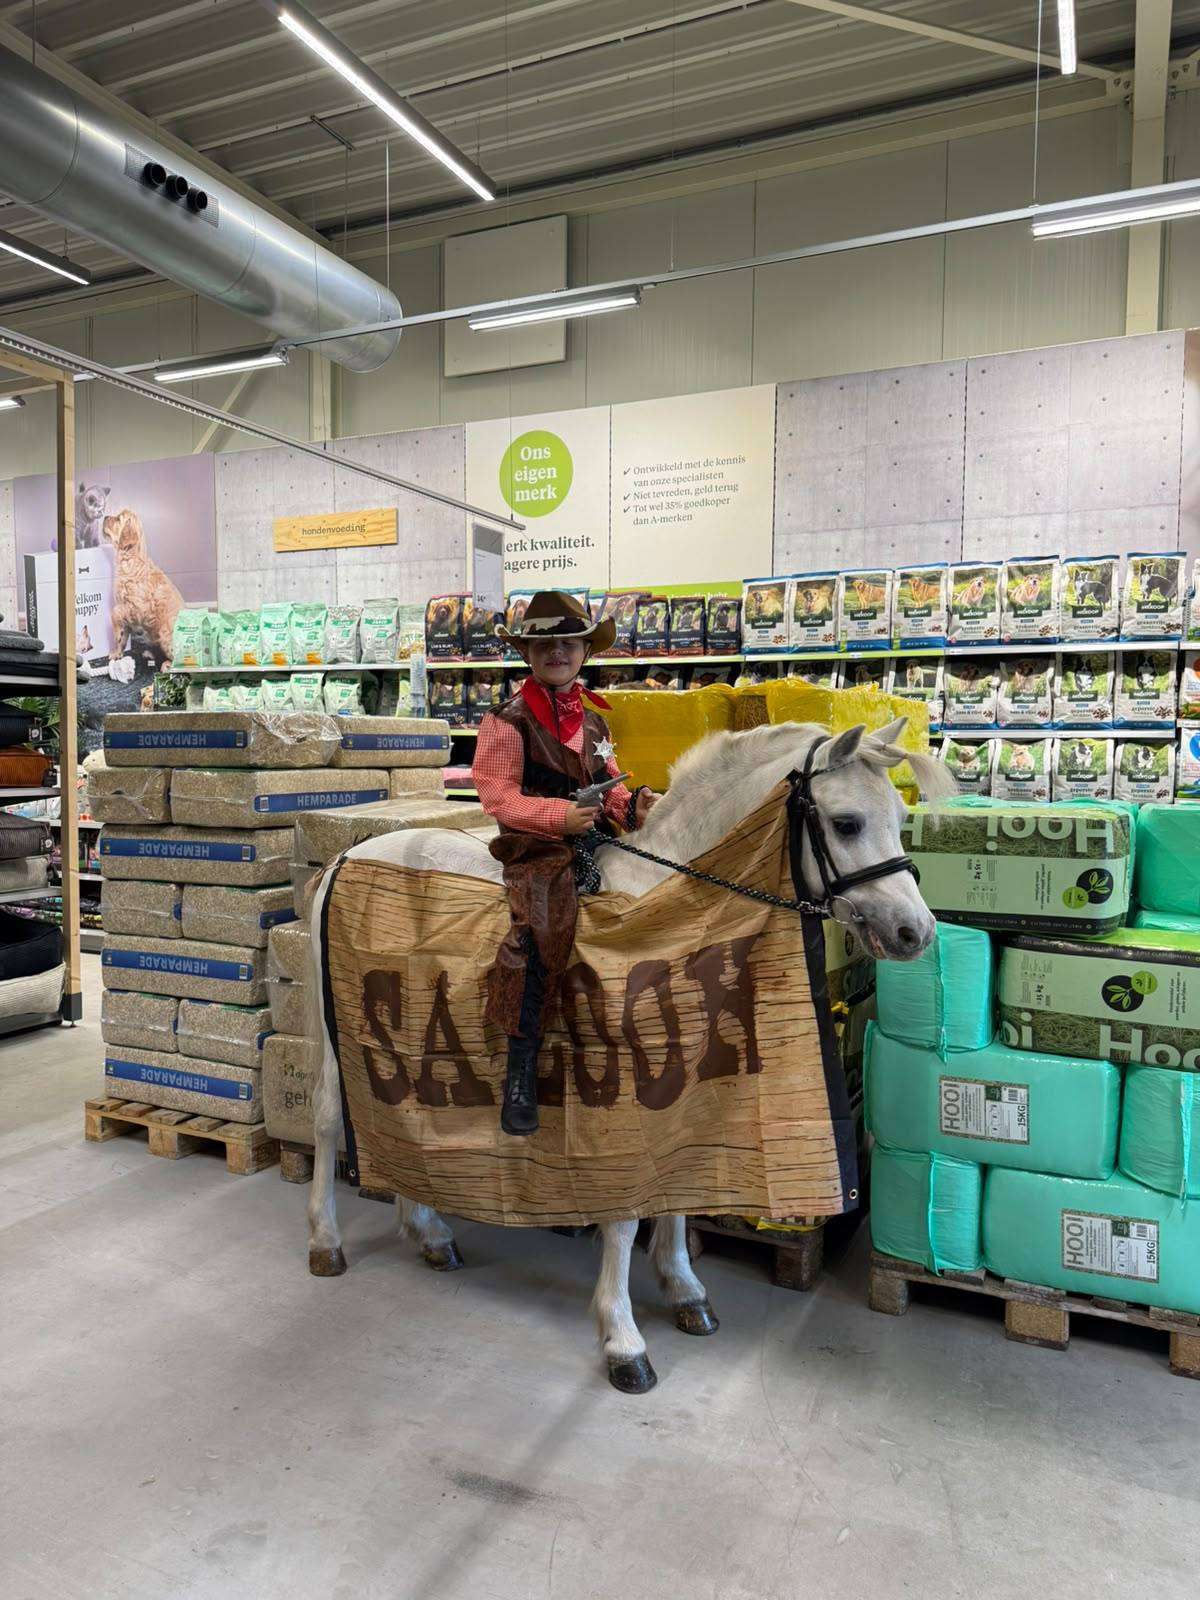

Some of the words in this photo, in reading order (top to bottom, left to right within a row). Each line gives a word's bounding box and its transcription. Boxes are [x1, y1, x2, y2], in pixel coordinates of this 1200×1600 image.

[520, 446, 552, 461] Ons
[633, 462, 682, 474] Ontwikkeld
[684, 460, 700, 469] met
[703, 458, 714, 467] de
[716, 454, 746, 466] kennis
[514, 466, 557, 484] eigen
[672, 472, 724, 486] specialisten
[515, 484, 558, 502] merk
[633, 490, 651, 500] Niet
[652, 488, 692, 499] tevreden,
[694, 484, 713, 496] geld
[715, 483, 739, 492] terug
[633, 504, 647, 512] Tot
[650, 502, 664, 512] wel
[665, 501, 682, 510] 35%
[684, 498, 730, 510] goedkoper
[633, 517, 649, 526] dan
[651, 514, 693, 524] A-merken
[302, 524, 366, 536] hondenvoeding
[504, 540, 528, 552] erk
[530, 535, 595, 551] kwaliteit.
[504, 558, 540, 572] agere
[542, 555, 577, 571] prijs.
[74, 593, 102, 604] elkom
[138, 732, 206, 746] HEMPARADE
[376, 736, 425, 748] HEMPARADE
[298, 793, 356, 807] HEMPARADE
[138, 842, 210, 858] HEMPARADE
[140, 955, 208, 974] HEMPARADE
[141, 1068, 208, 1091] HEMPARADE
[944, 1082, 960, 1130] HOOI
[1016, 1105, 1026, 1126] 15KG
[1066, 1216, 1084, 1265] HOOI
[1146, 1242, 1156, 1264] 15KG
